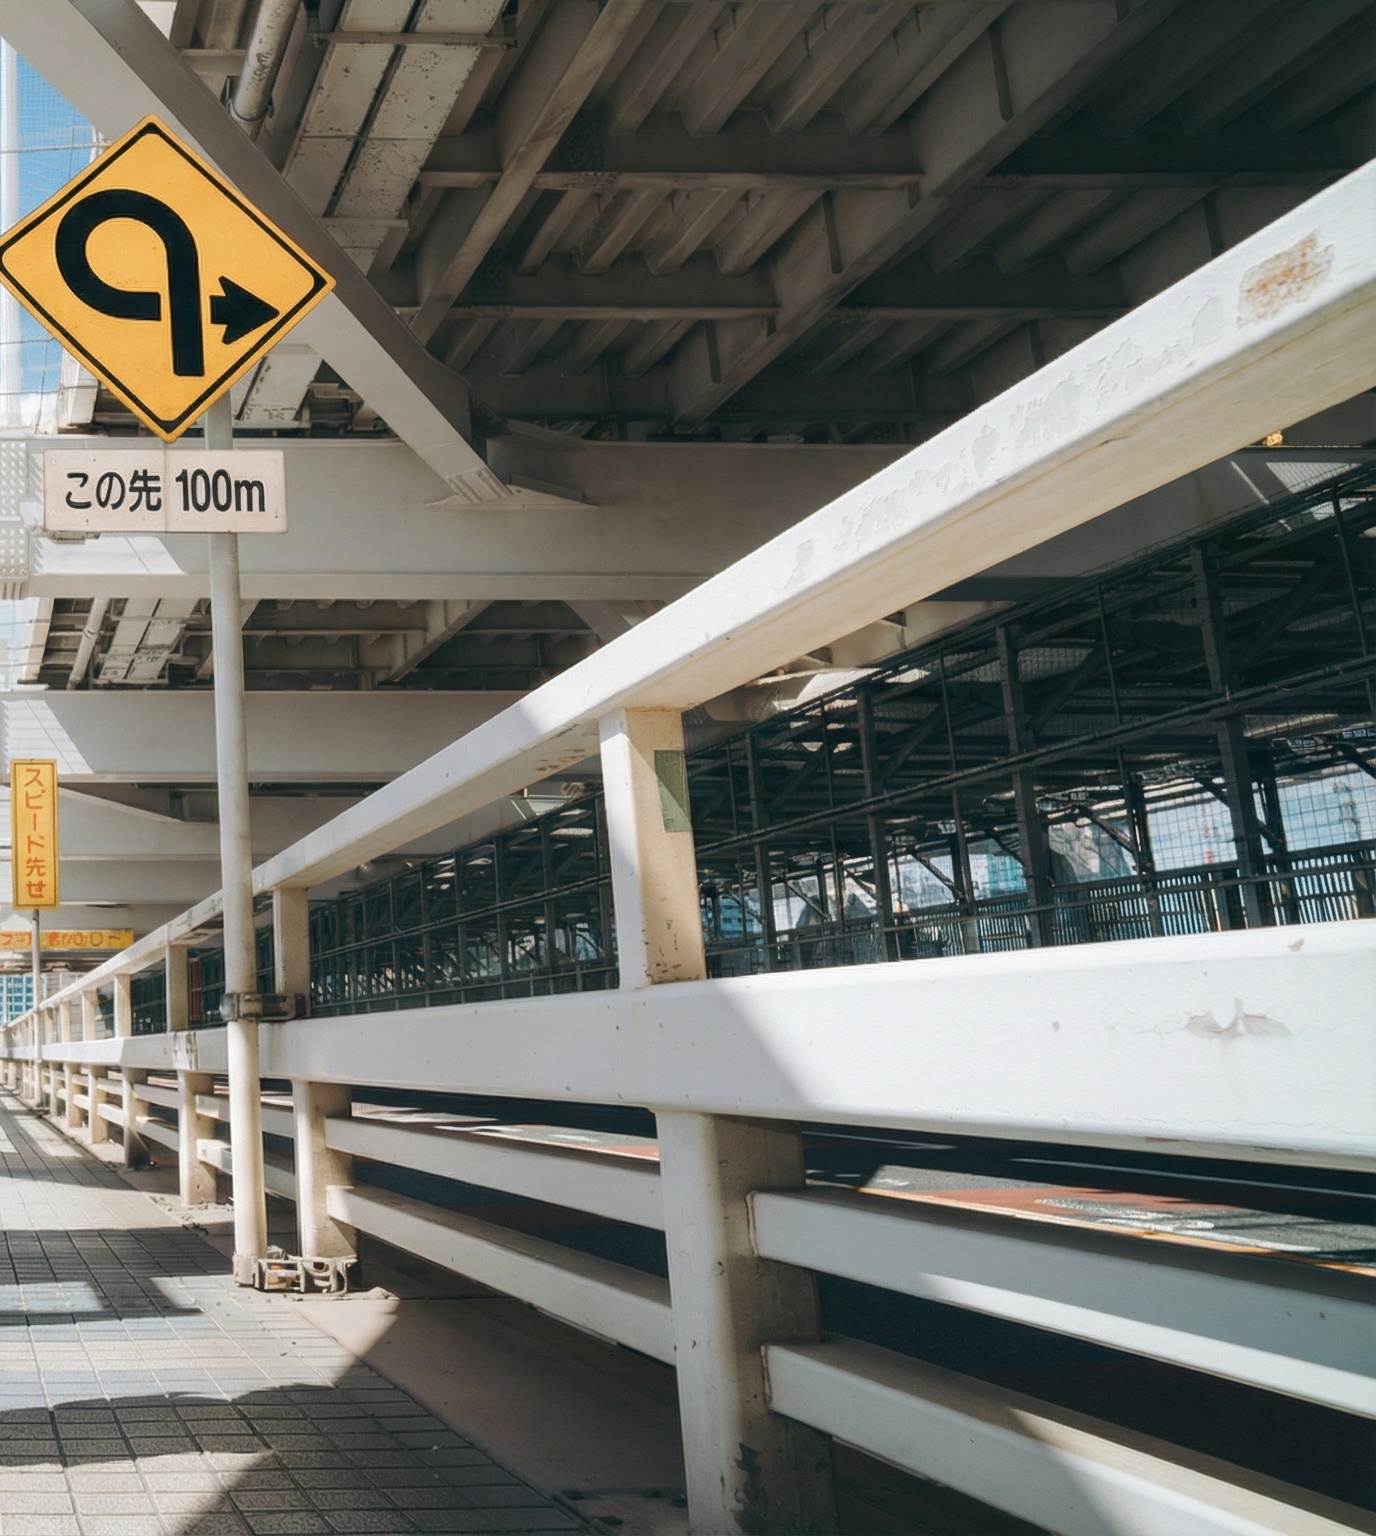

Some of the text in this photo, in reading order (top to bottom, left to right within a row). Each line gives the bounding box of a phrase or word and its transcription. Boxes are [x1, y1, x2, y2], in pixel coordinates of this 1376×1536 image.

[65, 469, 266, 512] この先 100m
